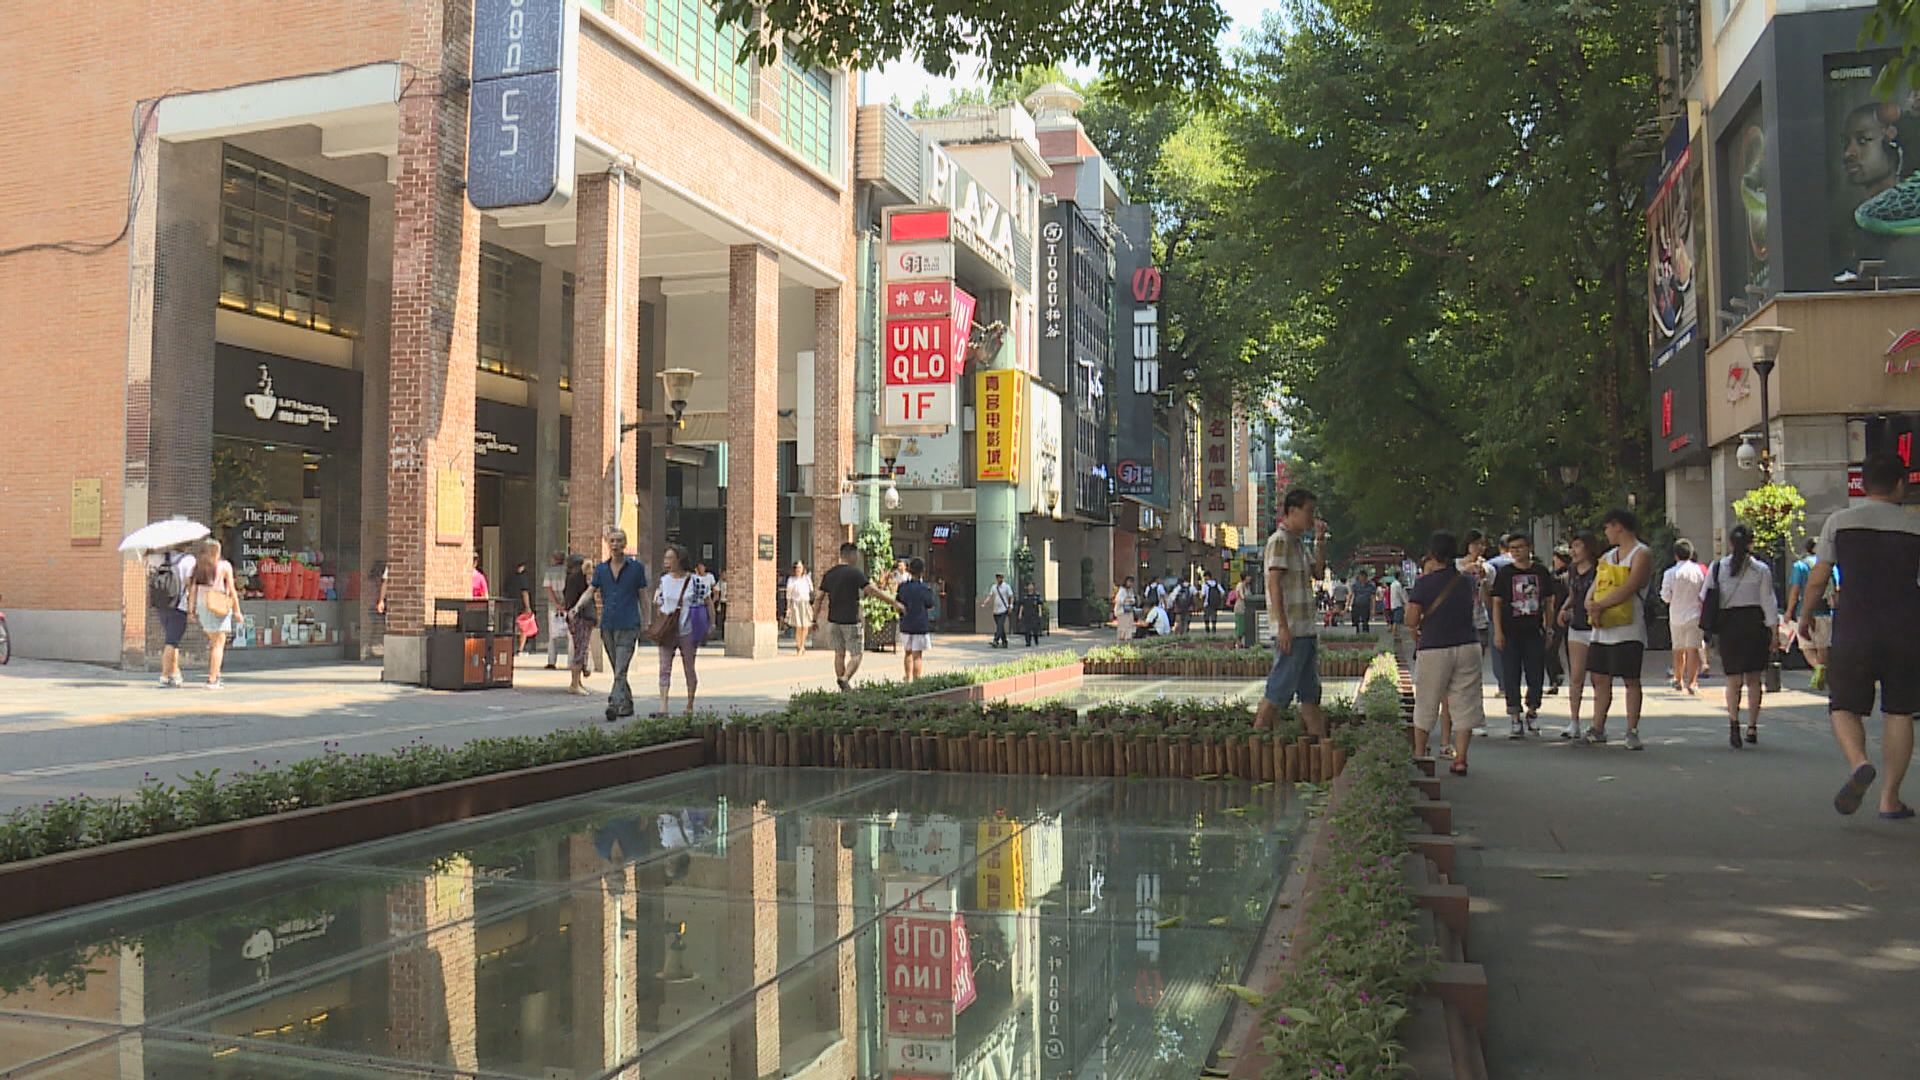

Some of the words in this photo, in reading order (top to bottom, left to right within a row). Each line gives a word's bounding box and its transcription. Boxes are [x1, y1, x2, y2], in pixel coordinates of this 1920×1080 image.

[502, 0, 525, 74] bo
[1047, 244, 1058, 307] TUOGU
[893, 325, 941, 351] UNI
[893, 353, 945, 383] QLO
[902, 391, 936, 420] 1F
[242, 508, 263, 522] The
[263, 510, 299, 525] pleasure
[242, 527, 254, 540] of
[255, 532, 262, 540] a
[262, 528, 285, 543] good
[242, 544, 281, 557] Bookstore
